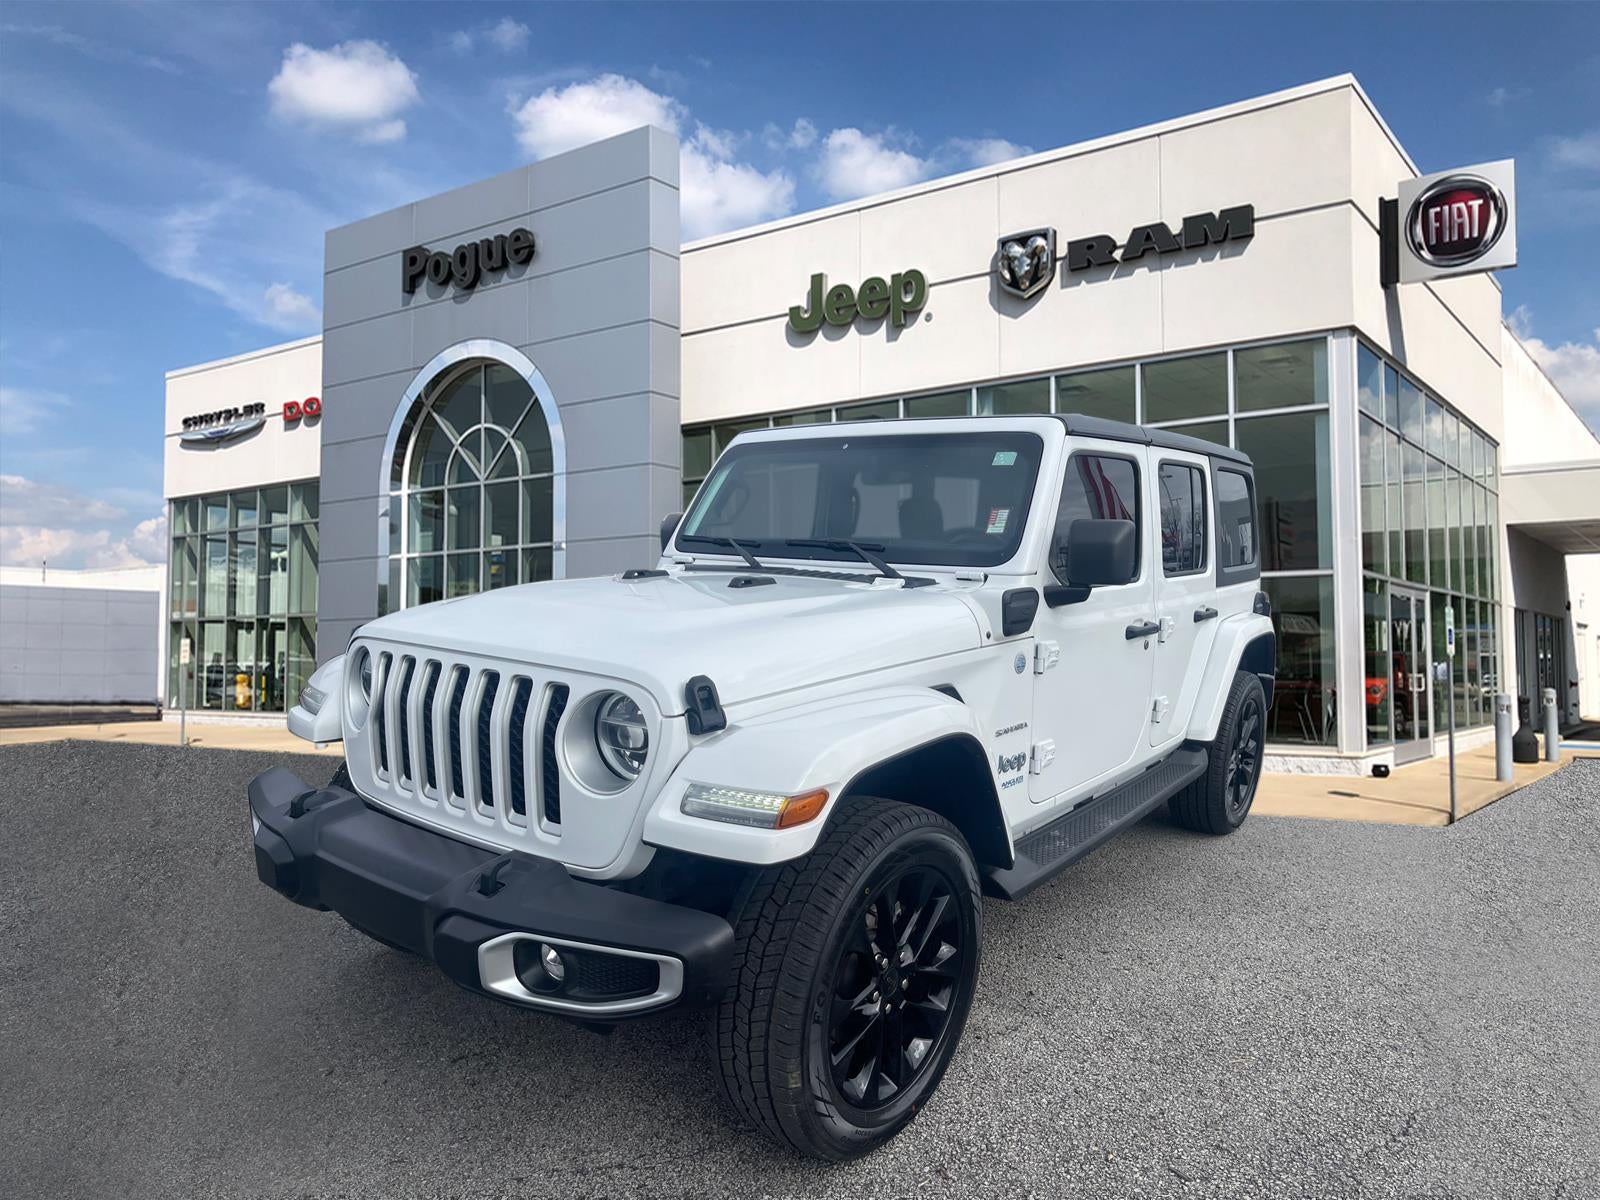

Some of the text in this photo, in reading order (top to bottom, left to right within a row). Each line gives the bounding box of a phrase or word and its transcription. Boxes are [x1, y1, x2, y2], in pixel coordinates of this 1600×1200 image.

[1066, 203, 1255, 272] RAM
[1428, 199, 1484, 246] FIAT
[402, 227, 536, 294] Pogue
[788, 268, 929, 332] Jeep
[182, 402, 265, 429] CHRYSLER
[998, 751, 1027, 774] Jeep
